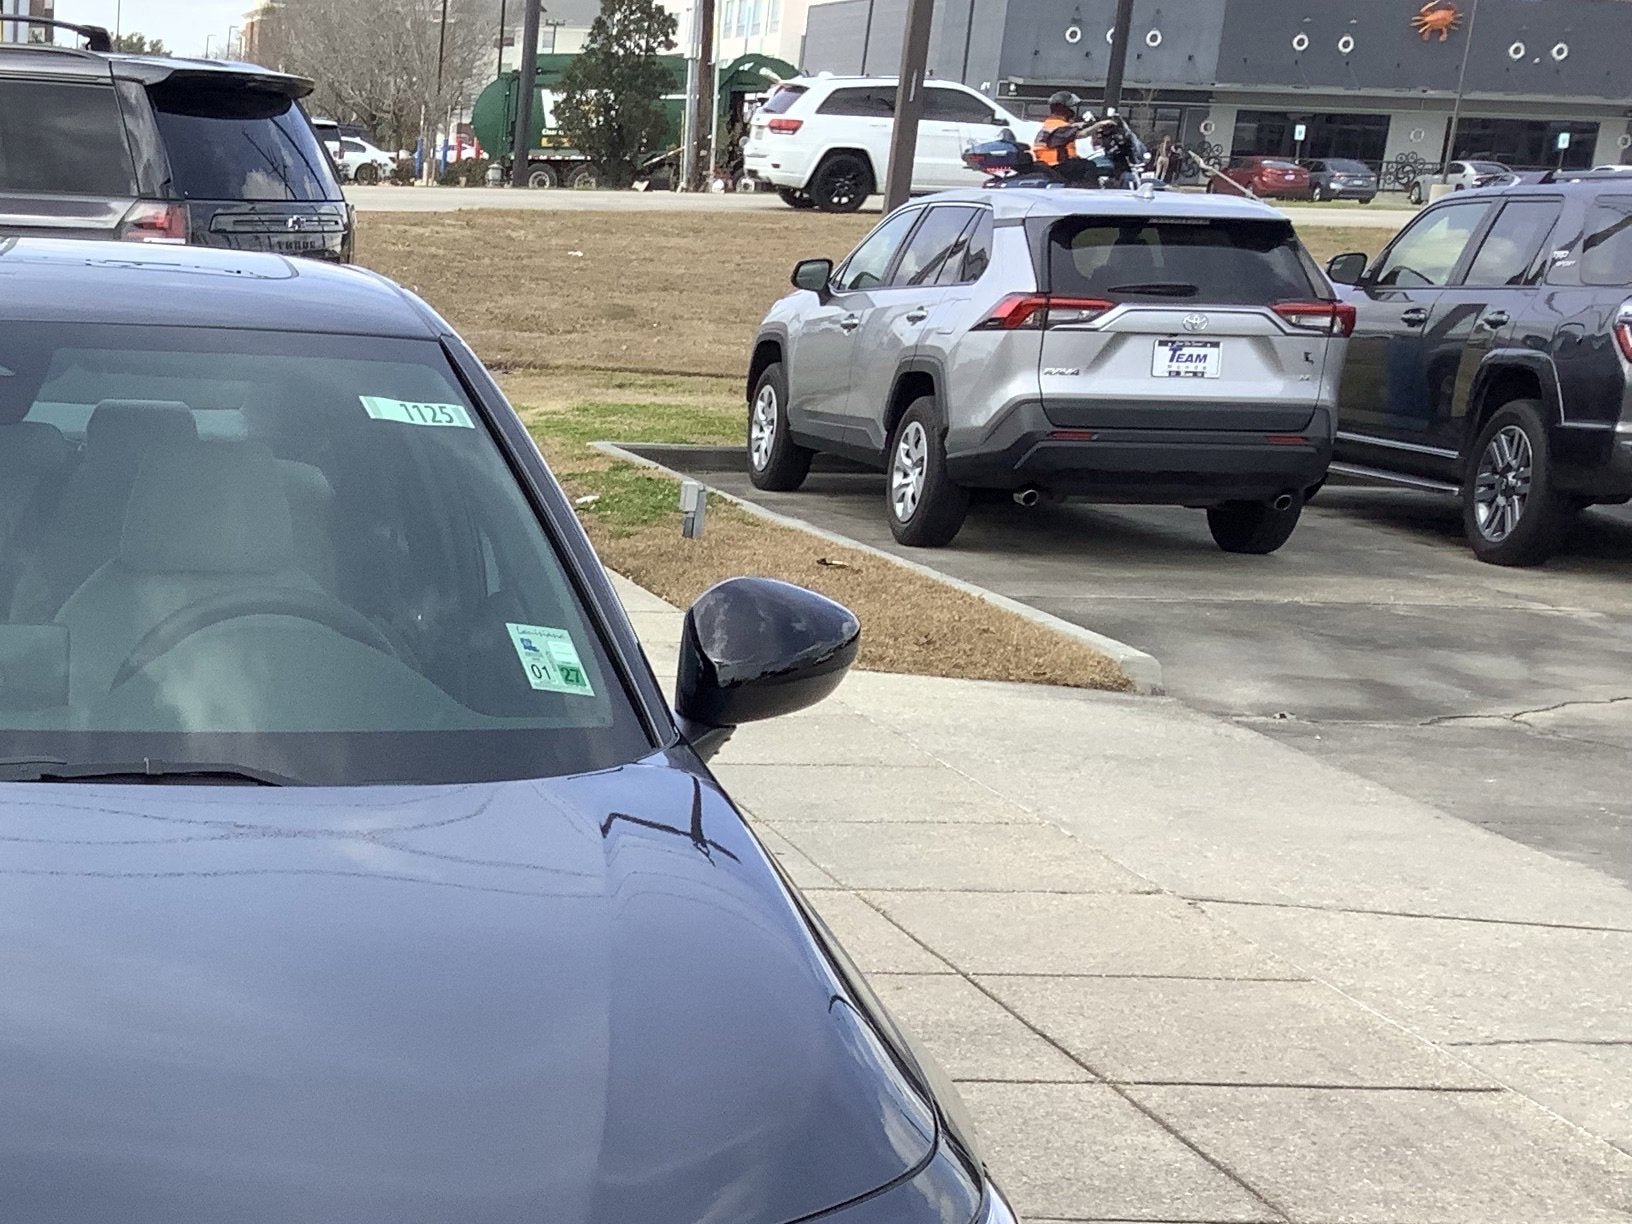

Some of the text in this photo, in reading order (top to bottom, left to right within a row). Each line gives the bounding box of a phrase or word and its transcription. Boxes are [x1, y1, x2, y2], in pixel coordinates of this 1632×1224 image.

[1169, 344, 1208, 364] TEAM
[399, 403, 454, 424] 1125
[531, 664, 551, 680] 01
[560, 667, 580, 684] 27
